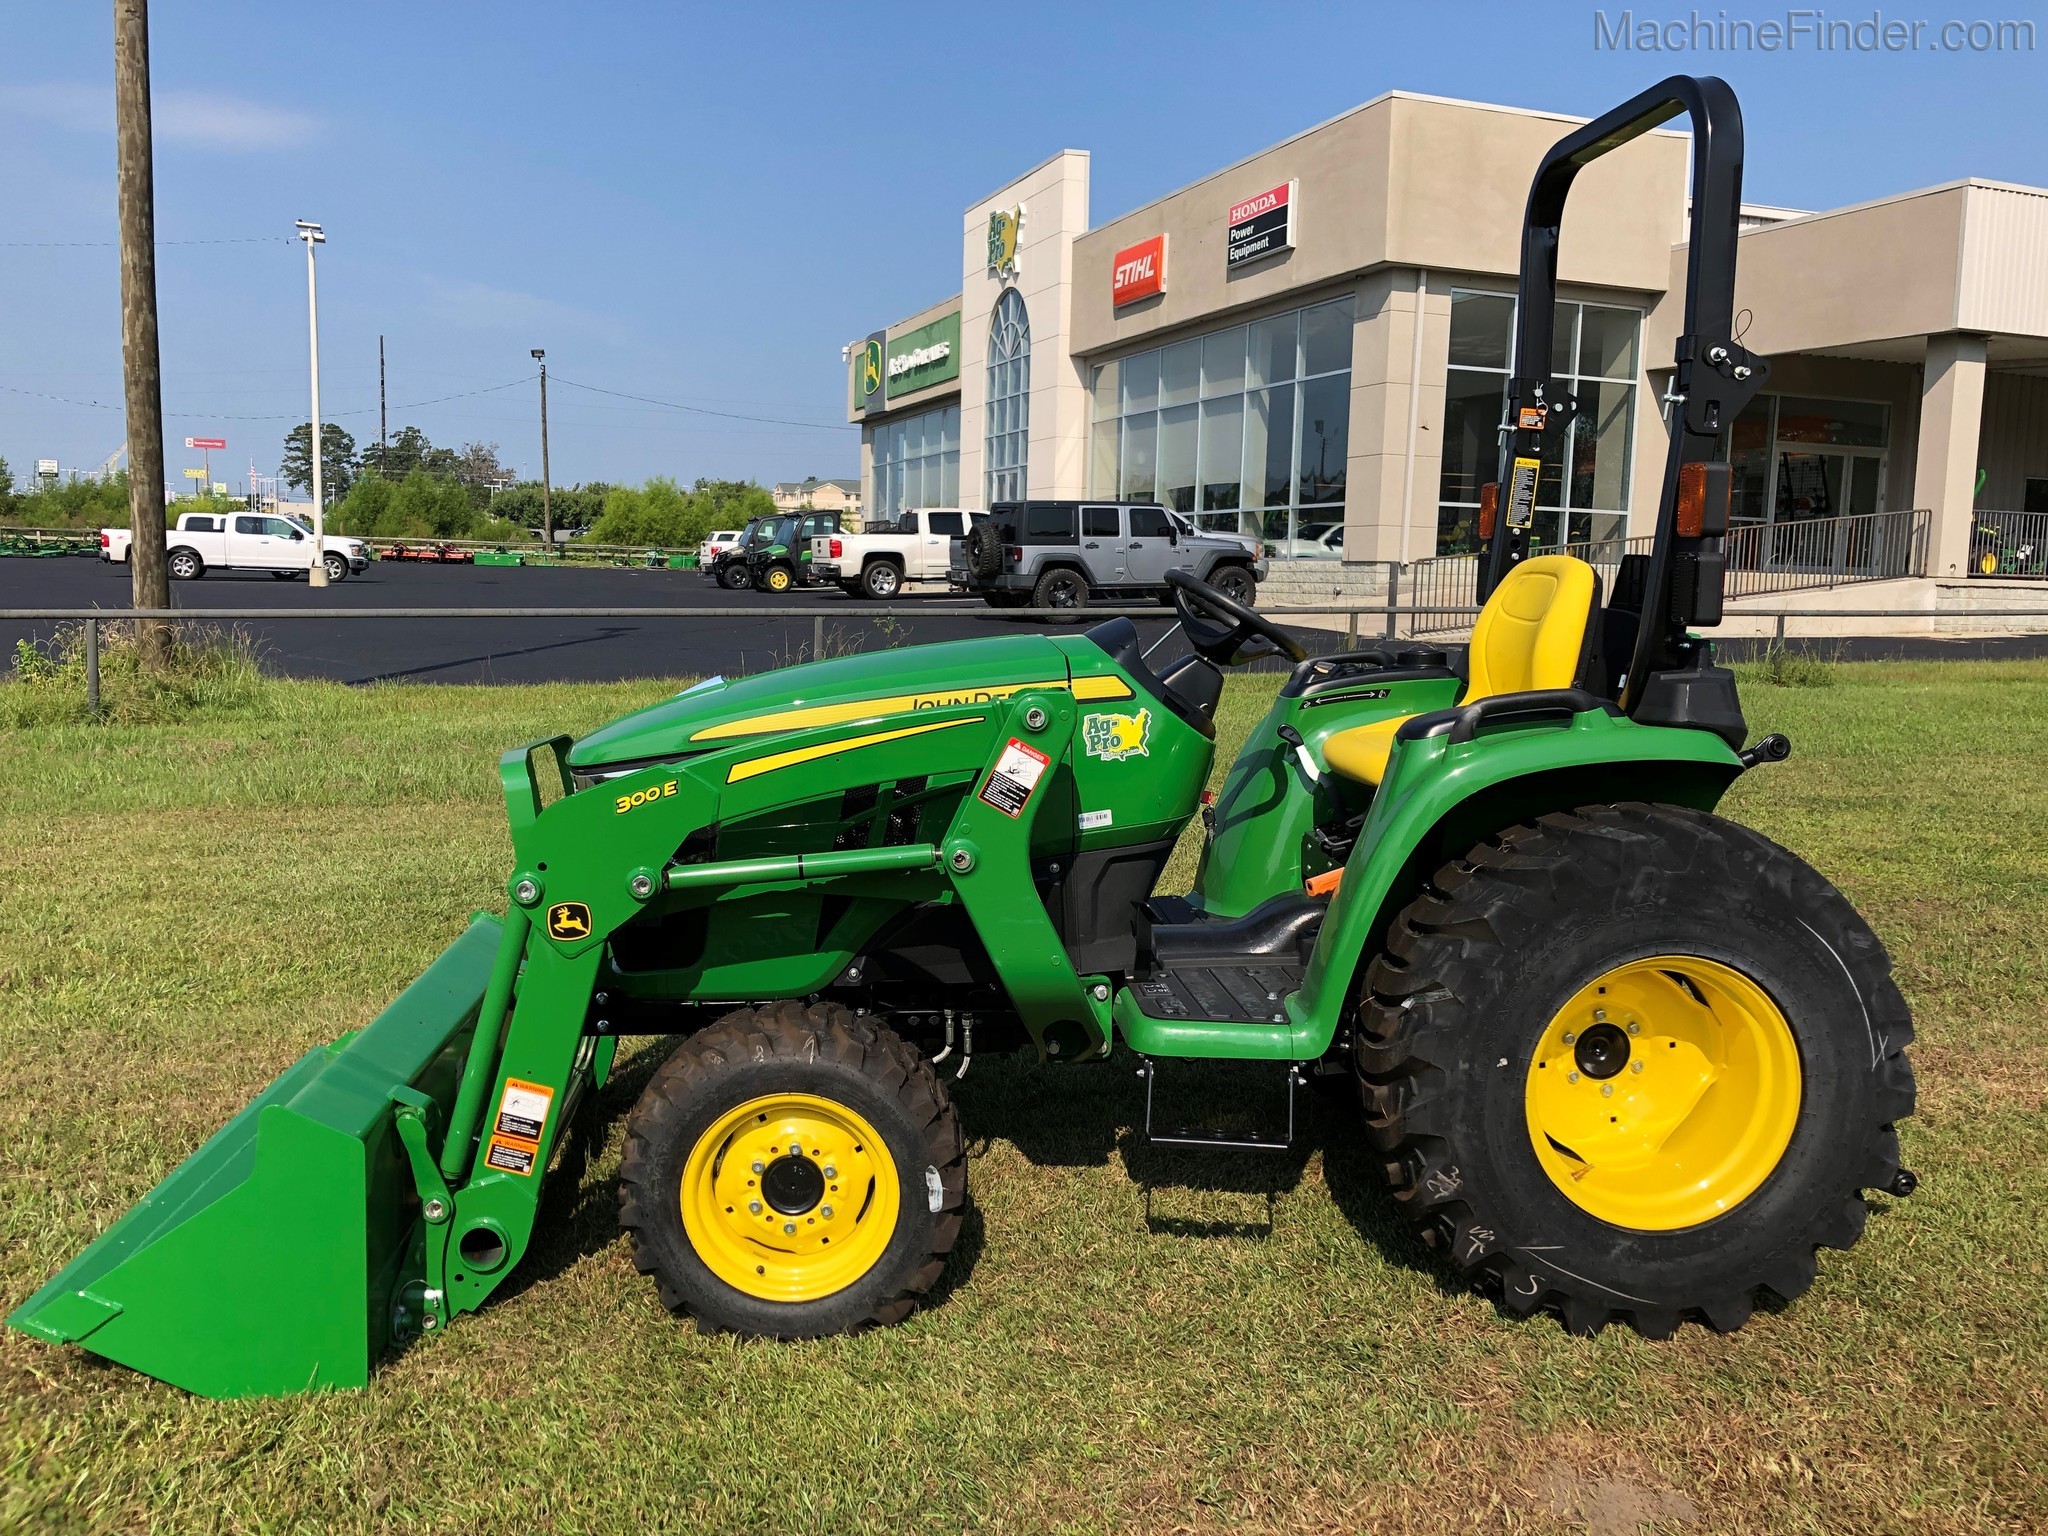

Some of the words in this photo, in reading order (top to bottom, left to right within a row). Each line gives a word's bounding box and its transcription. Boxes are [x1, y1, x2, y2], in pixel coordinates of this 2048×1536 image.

[1232, 194, 1277, 221] HONDA
[1231, 225, 1254, 241] Power
[1230, 236, 1269, 260] Equipment
[1114, 254, 1154, 290] STIHL
[1089, 734, 1121, 752] Pro
[1021, 745, 1045, 762] DANGER
[519, 1083, 548, 1095] WARNING
[504, 1140, 533, 1151] WARNING
